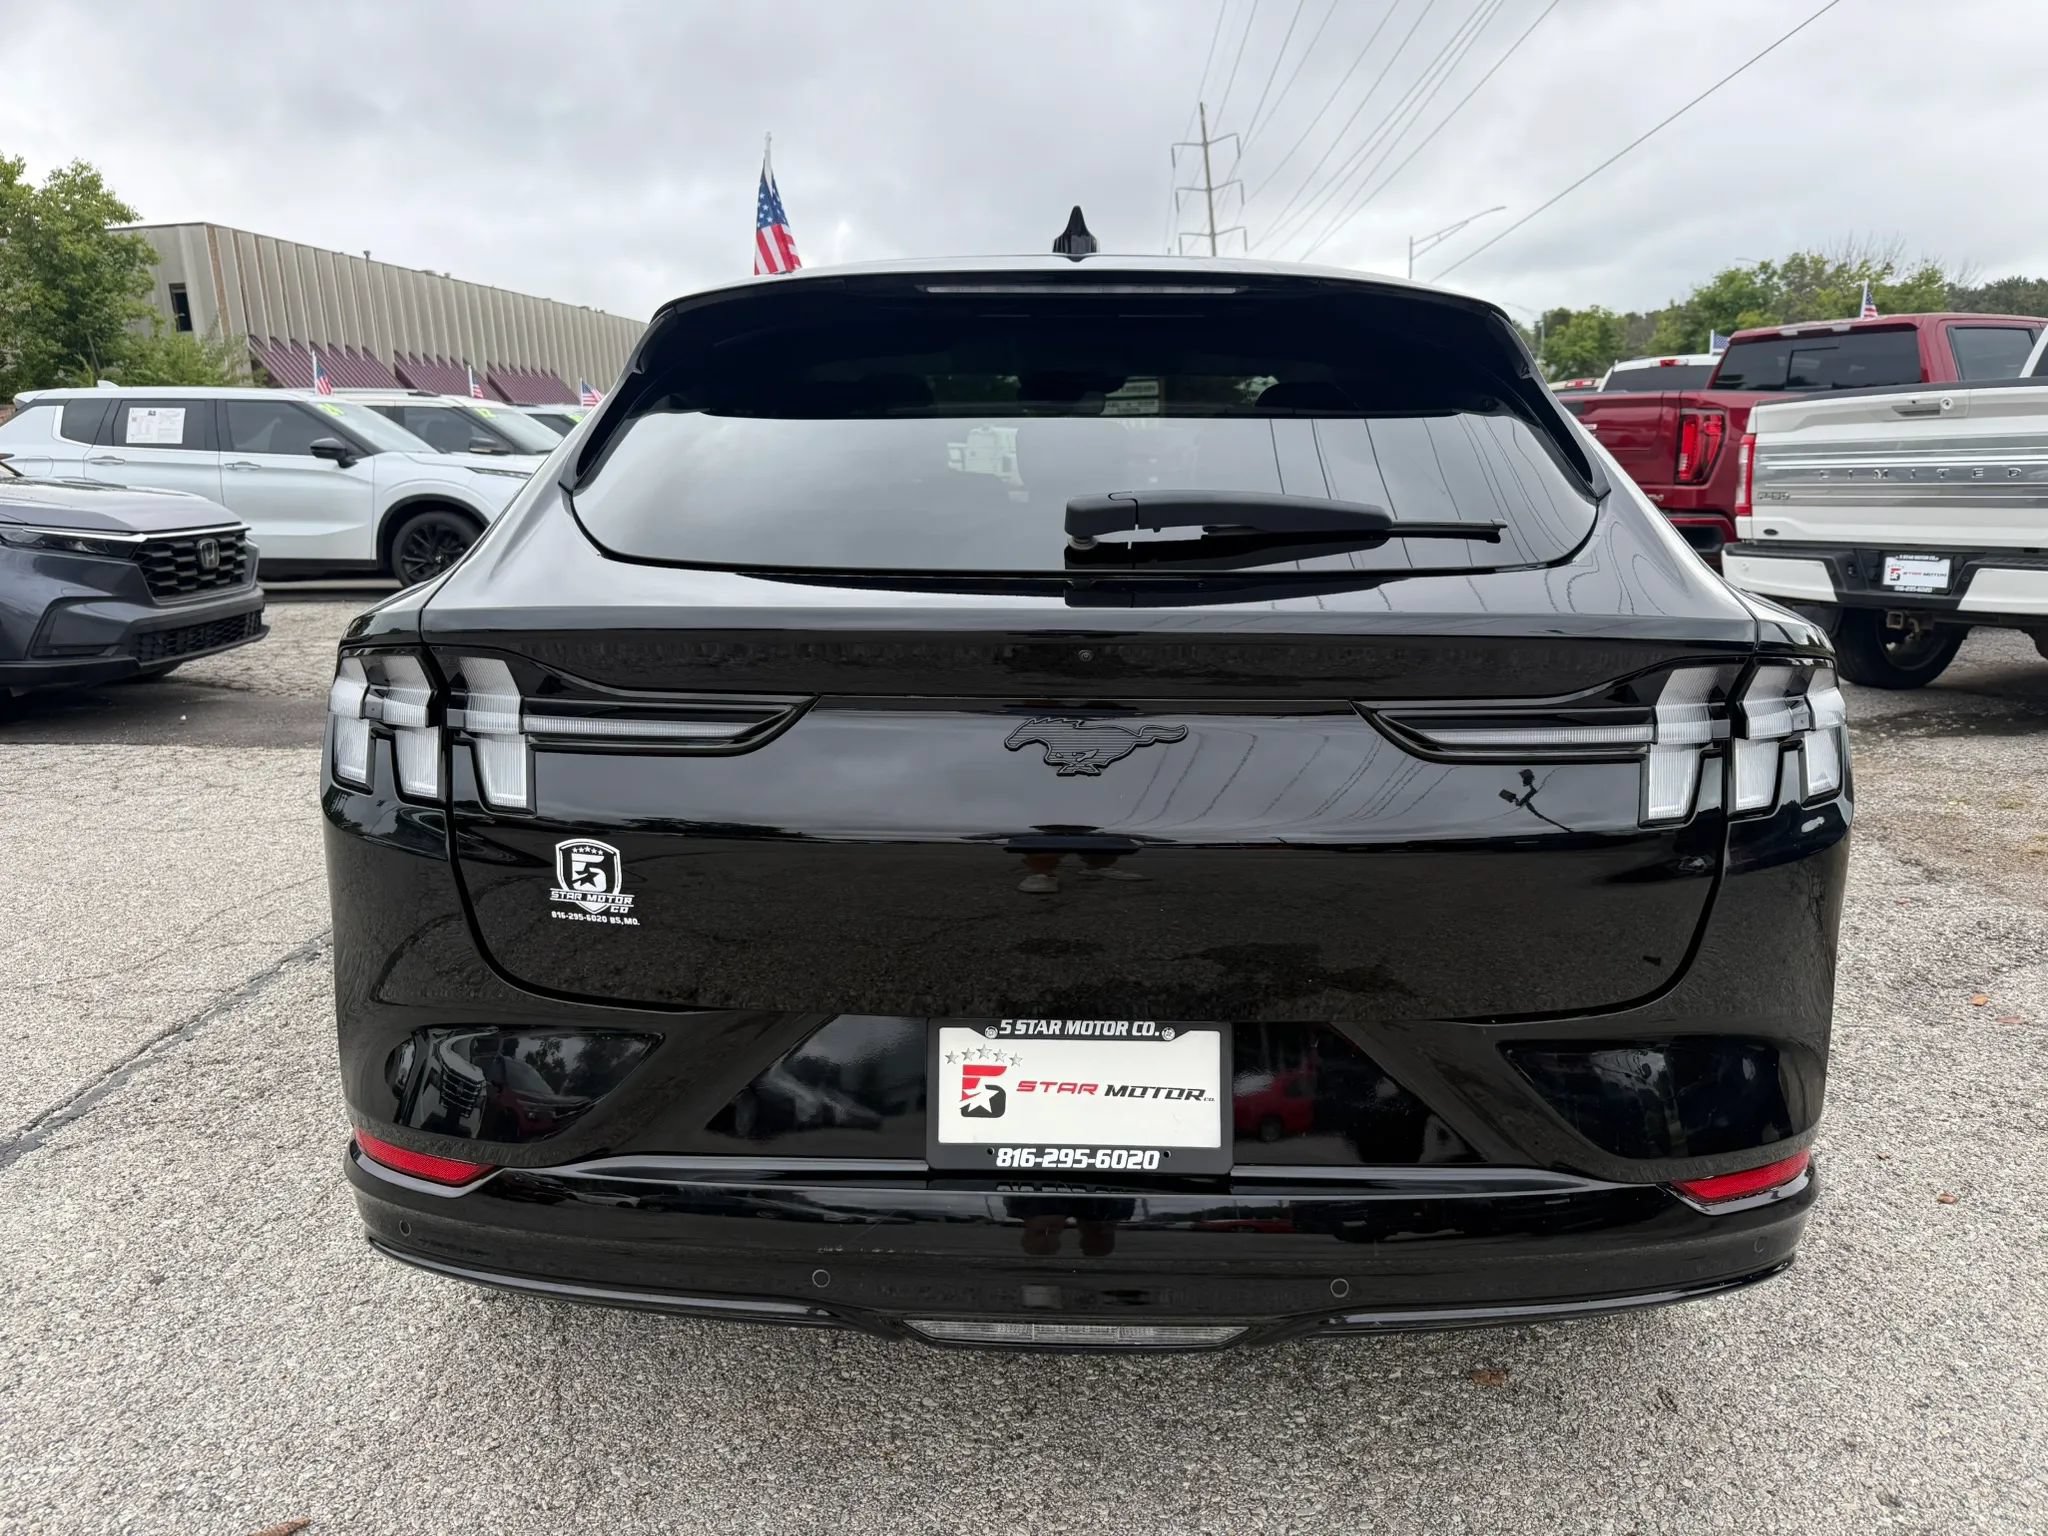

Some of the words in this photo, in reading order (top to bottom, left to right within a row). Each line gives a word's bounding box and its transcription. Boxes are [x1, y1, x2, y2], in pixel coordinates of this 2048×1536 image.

[1818, 467, 2022, 480] LIMITED
[550, 891, 582, 901] STAR
[586, 894, 633, 904] MOTOR
[610, 906, 629, 914] CO
[999, 1020, 1013, 1035] 5
[1014, 1020, 1062, 1035] STAR
[1064, 1021, 1129, 1036] MOTOR
[1131, 1021, 1160, 1036] CO.
[1016, 1080, 1099, 1095] STAR
[1104, 1084, 1206, 1101] MOTOR
[996, 1148, 1160, 1170] 816-295-6020
